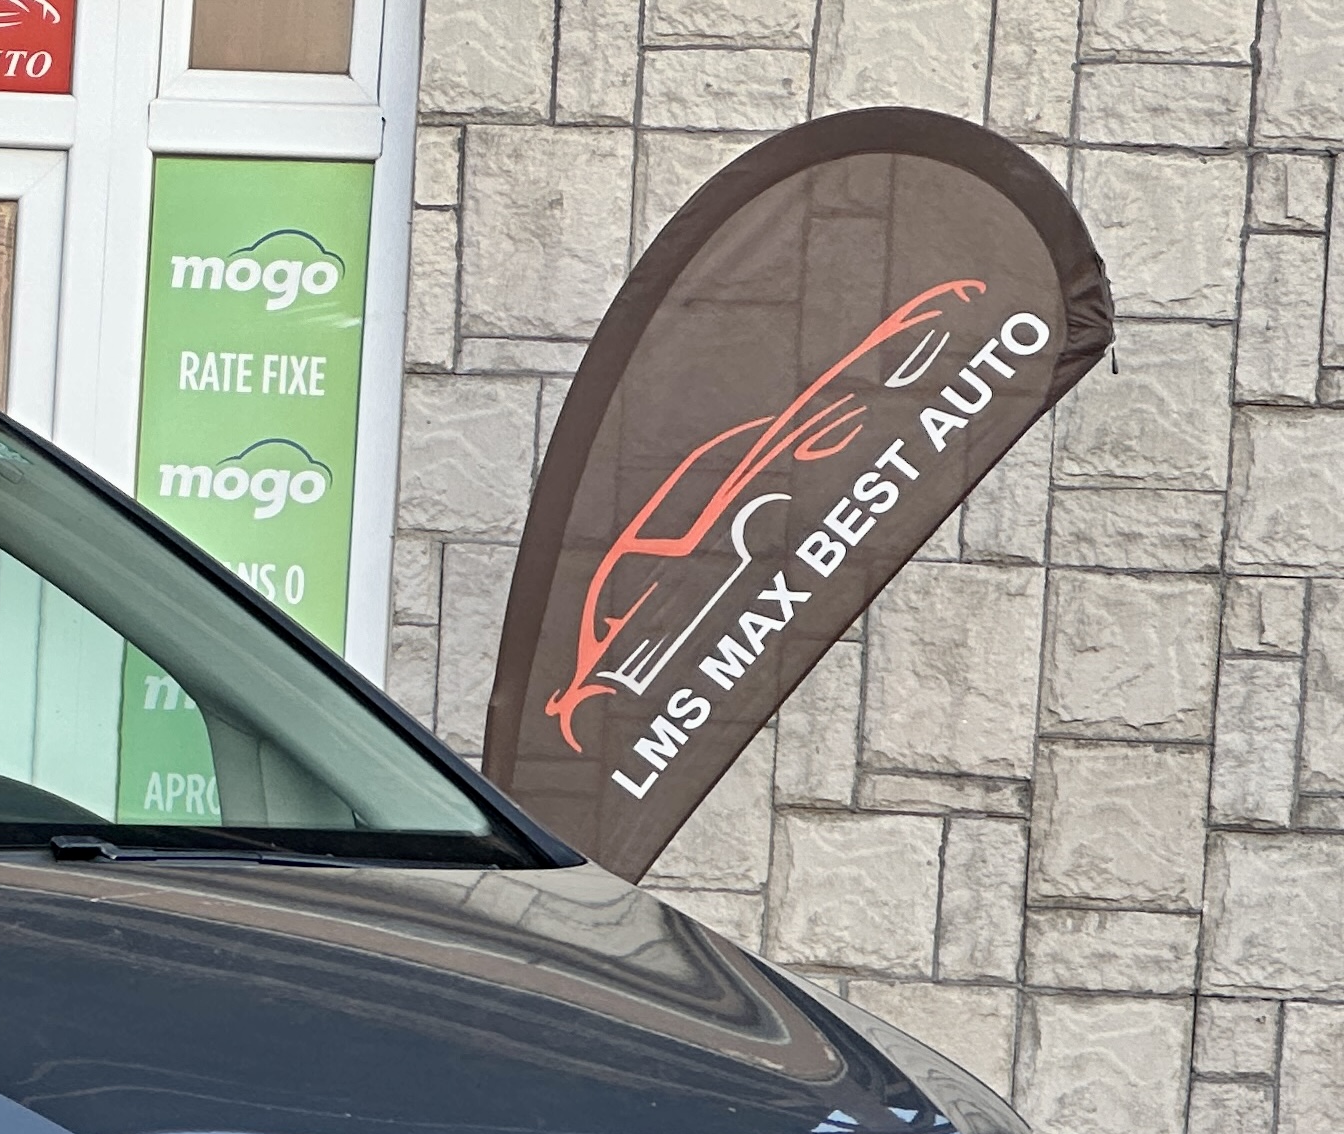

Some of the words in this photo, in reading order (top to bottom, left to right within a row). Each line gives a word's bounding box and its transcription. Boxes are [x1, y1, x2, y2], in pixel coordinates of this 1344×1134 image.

[170, 252, 338, 310] mogo
[179, 350, 252, 395] RATE
[262, 354, 326, 397] FIXE
[159, 460, 326, 519] mogo
[612, 687, 712, 799] LMS
[698, 571, 812, 692] MAX
[796, 438, 922, 578] BEST
[919, 311, 1051, 453] AUTO
